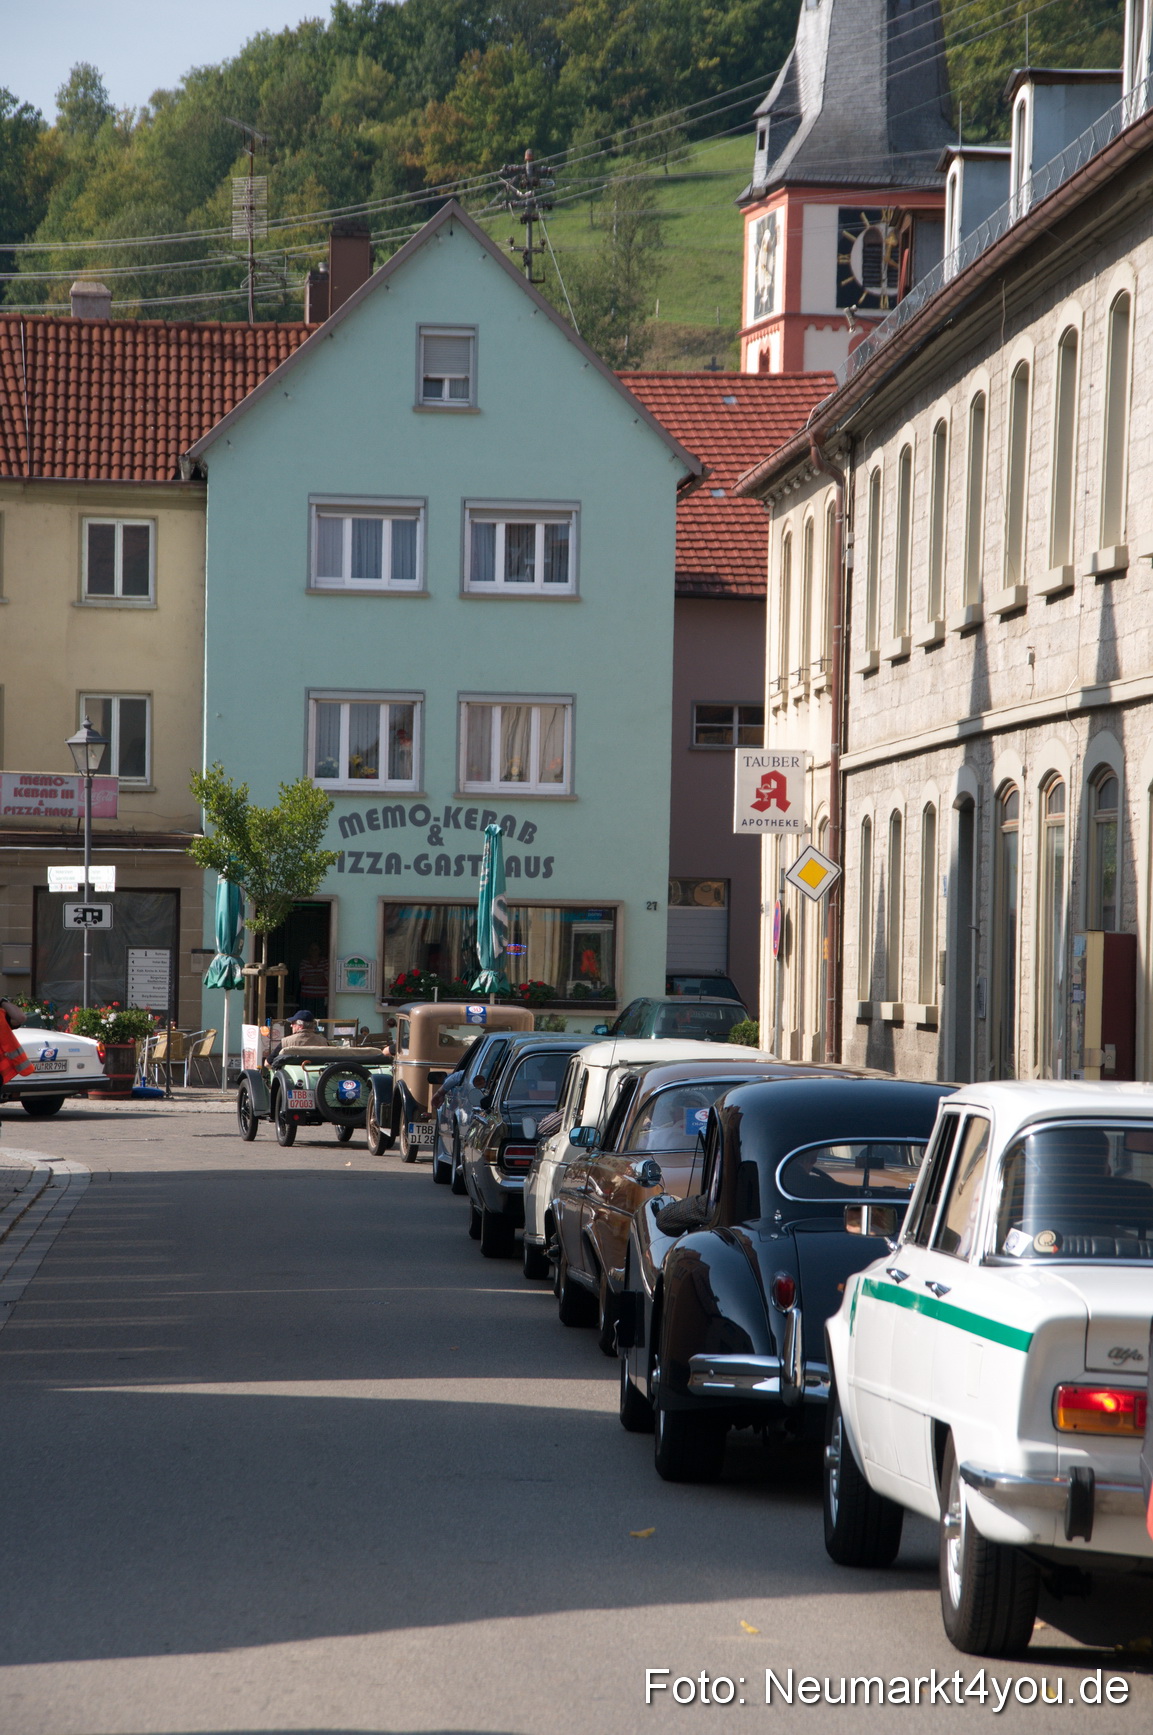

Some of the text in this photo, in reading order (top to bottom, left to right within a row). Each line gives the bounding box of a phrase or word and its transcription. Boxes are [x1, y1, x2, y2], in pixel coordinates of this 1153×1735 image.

[743, 755, 800, 768] TAUBER
[20, 776, 69, 786] MEMO-
[13, 788, 58, 799] KEBAB
[4, 806, 74, 817] PIZZA-HAUS
[338, 804, 538, 844] MEMO-KEBAB
[741, 818, 799, 828] APOTHEKE
[427, 824, 444, 846] &
[337, 851, 555, 878] IZZA-GASTAUS
[646, 901, 658, 911] 27
[293, 1090, 307, 1099] TBB
[290, 1100, 313, 1108] 07003
[416, 1125, 434, 1135] TBB
[411, 1134, 422, 1144] DI
